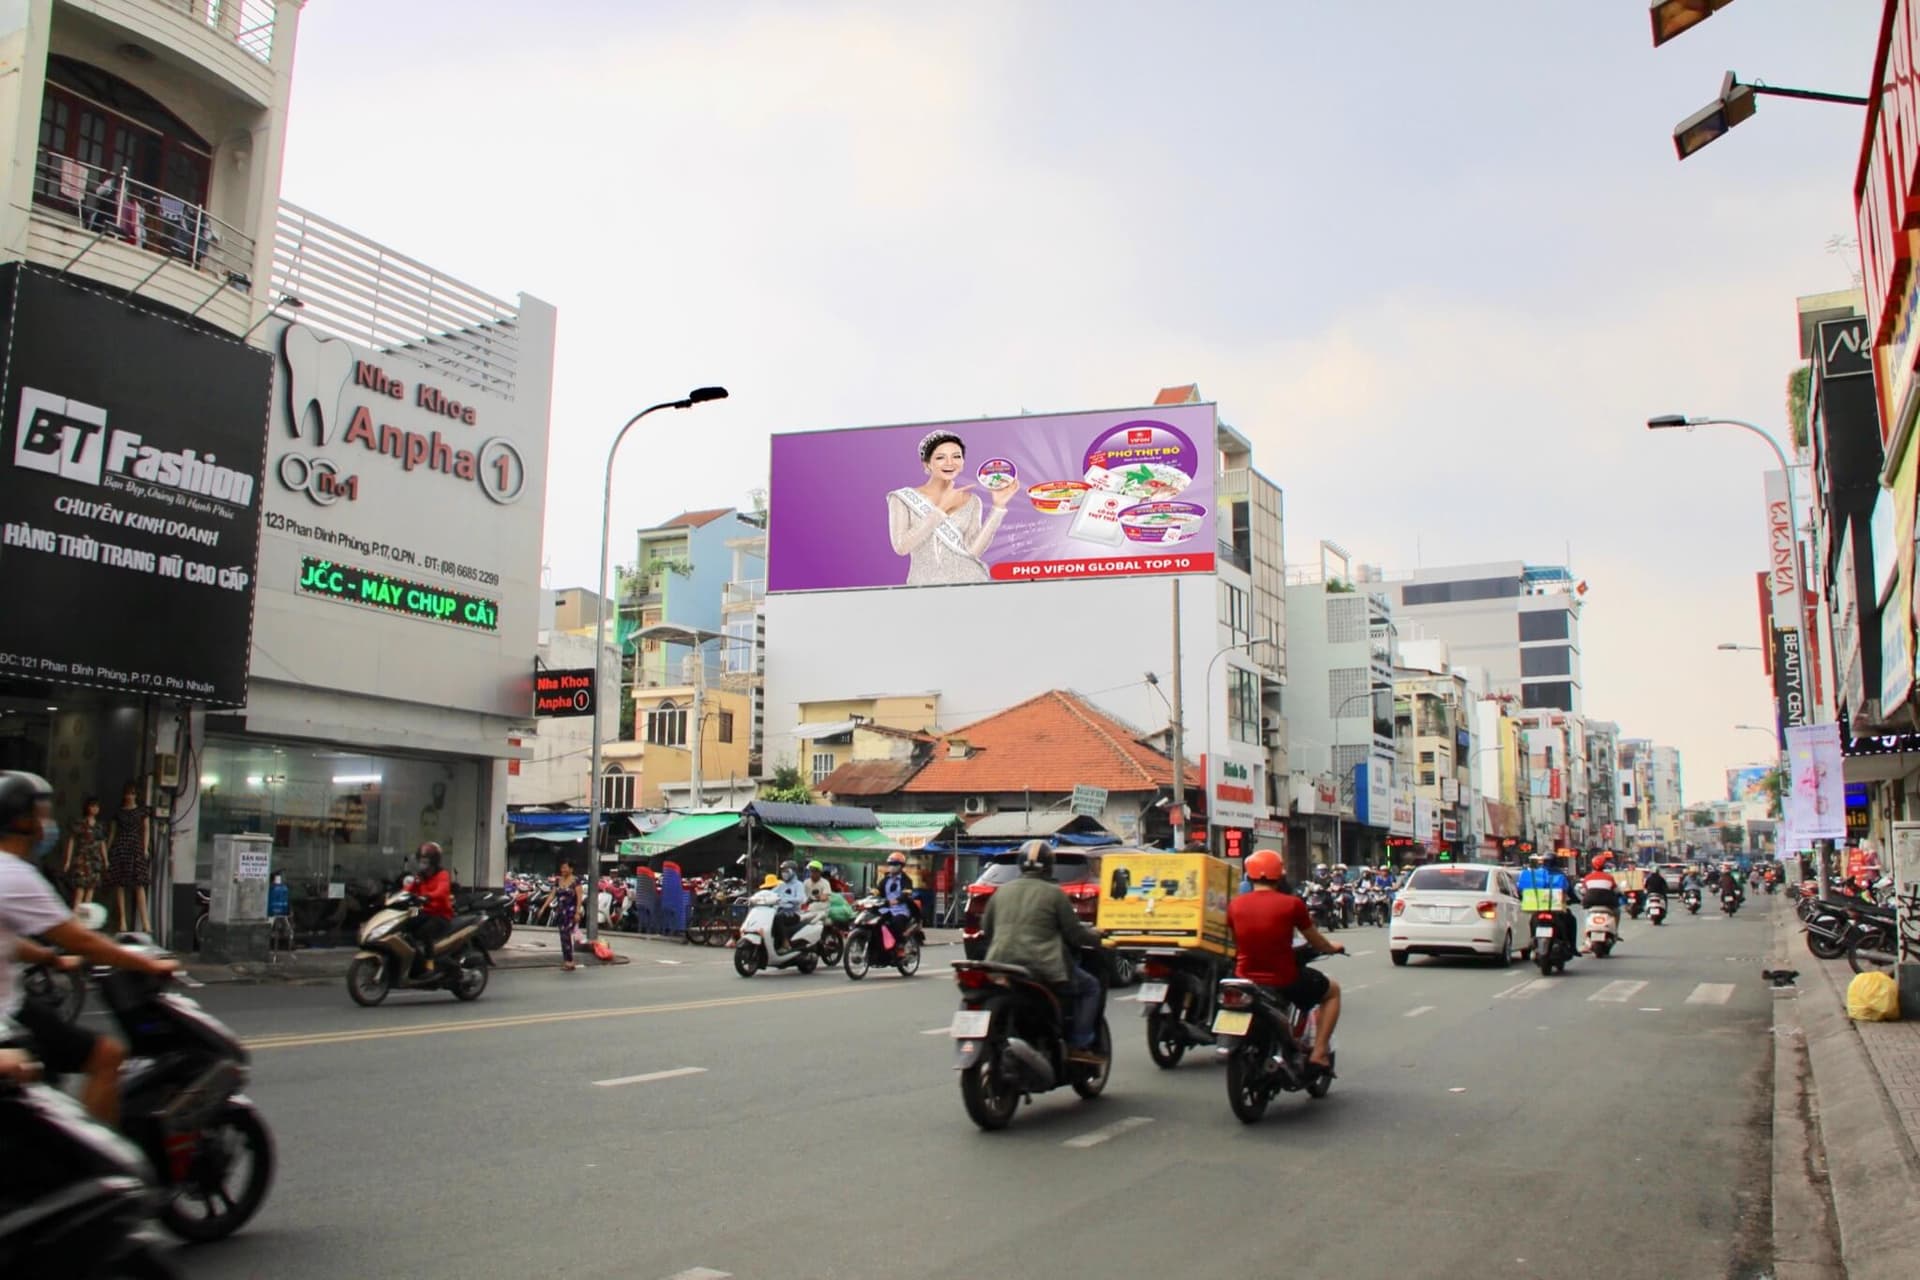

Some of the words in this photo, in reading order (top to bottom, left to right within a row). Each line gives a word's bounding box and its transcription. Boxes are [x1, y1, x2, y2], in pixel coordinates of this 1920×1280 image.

[356, 360, 404, 400] Nha
[417, 383, 477, 426] Khoa
[345, 405, 475, 481] Anpha
[105, 429, 254, 507] Fashion
[54, 496, 124, 525] CHUYÊN
[124, 512, 166, 536] KINH
[165, 521, 220, 547] DOANH
[264, 511, 285, 531] 123
[286, 518, 313, 538] Phan
[314, 526, 337, 545] Đình
[3, 521, 57, 554] HÀNG
[57, 533, 99, 563] THỜI
[99, 543, 156, 573] TRANG
[158, 554, 185, 579] NỮ
[184, 562, 216, 586] CAO
[218, 565, 250, 592] CẤP
[1012, 566, 1041, 576] PHO
[1044, 564, 1085, 574] VIFON
[1088, 561, 1141, 572] GLOBAL
[1144, 559, 1172, 569] TOP
[1176, 558, 1191, 568] 10
[361, 577, 404, 606] MÁY
[407, 590, 457, 621] CHỤP
[21, 656, 37, 668] 121
[40, 658, 68, 673] Phan
[71, 663, 95, 677] Đình
[537, 677, 559, 690] Nha
[561, 675, 590, 689] Khoa
[1783, 633, 1801, 689] BEAUTY
[538, 696, 572, 711] Anpha
